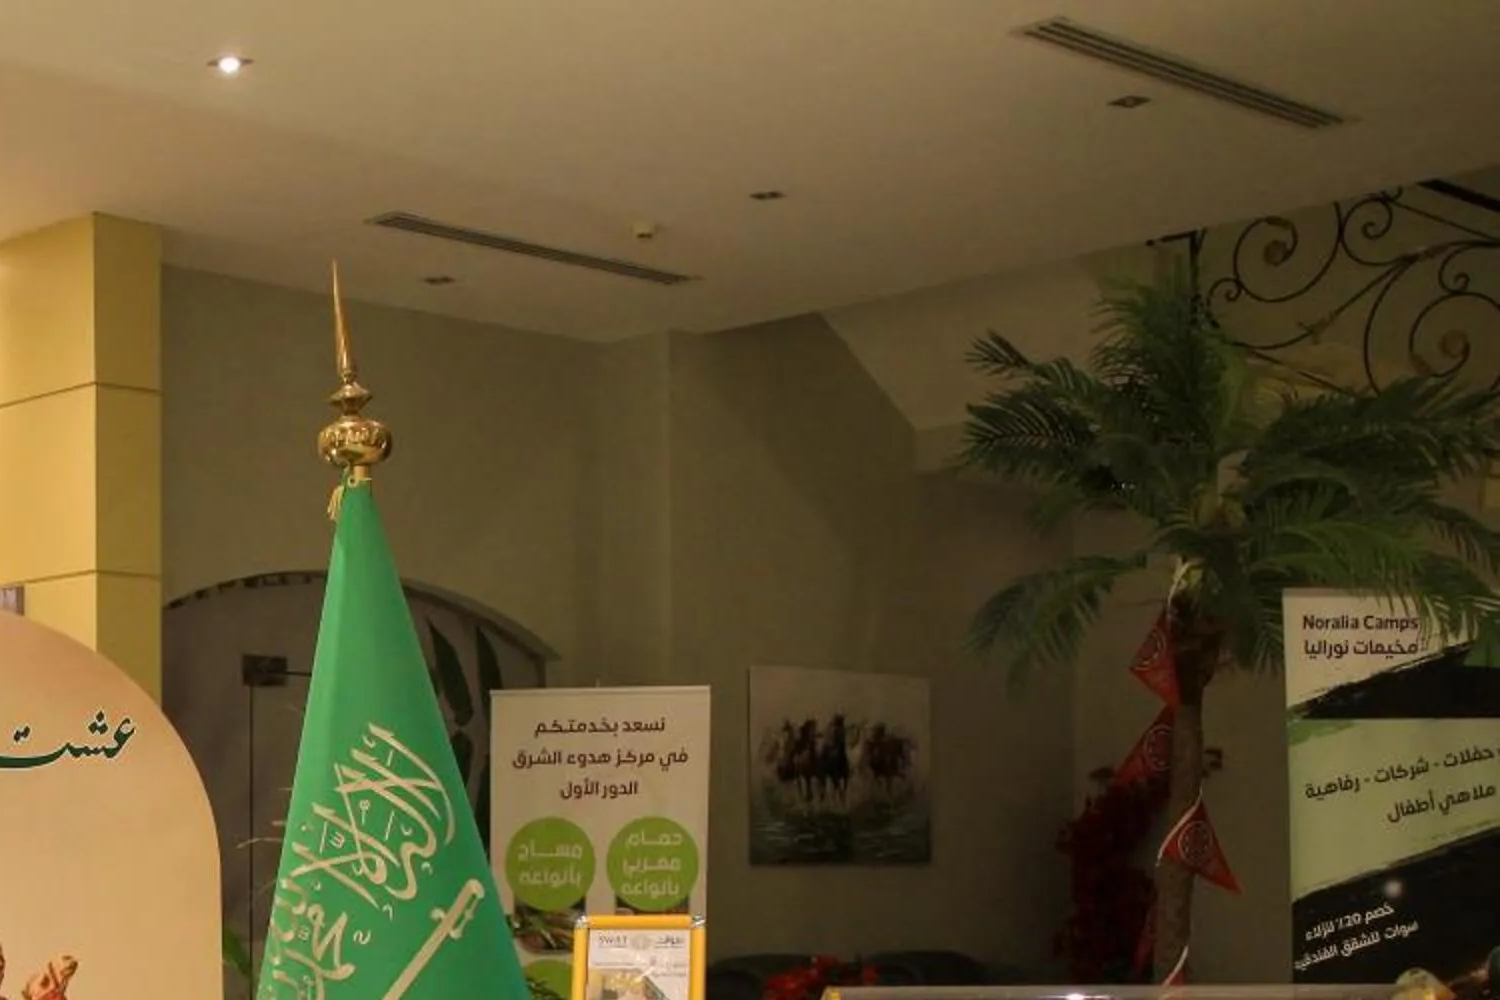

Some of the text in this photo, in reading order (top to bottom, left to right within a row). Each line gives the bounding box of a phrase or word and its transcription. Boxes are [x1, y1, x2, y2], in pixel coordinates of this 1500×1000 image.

[1302, 615, 1419, 633] Noralia Camps
[534, 717, 665, 738] نسعد بخدمتكم
[512, 746, 689, 772] في مركز هدوء الشرق
[1305, 745, 1495, 800] حفلات شركات رفاهية
[560, 777, 639, 799] الدور الأول
[1387, 784, 1496, 824] ملاهي أطفال
[625, 830, 683, 849] حمام
[1365, 901, 1395, 925] خصم
[1384, 920, 1419, 940] سوات
